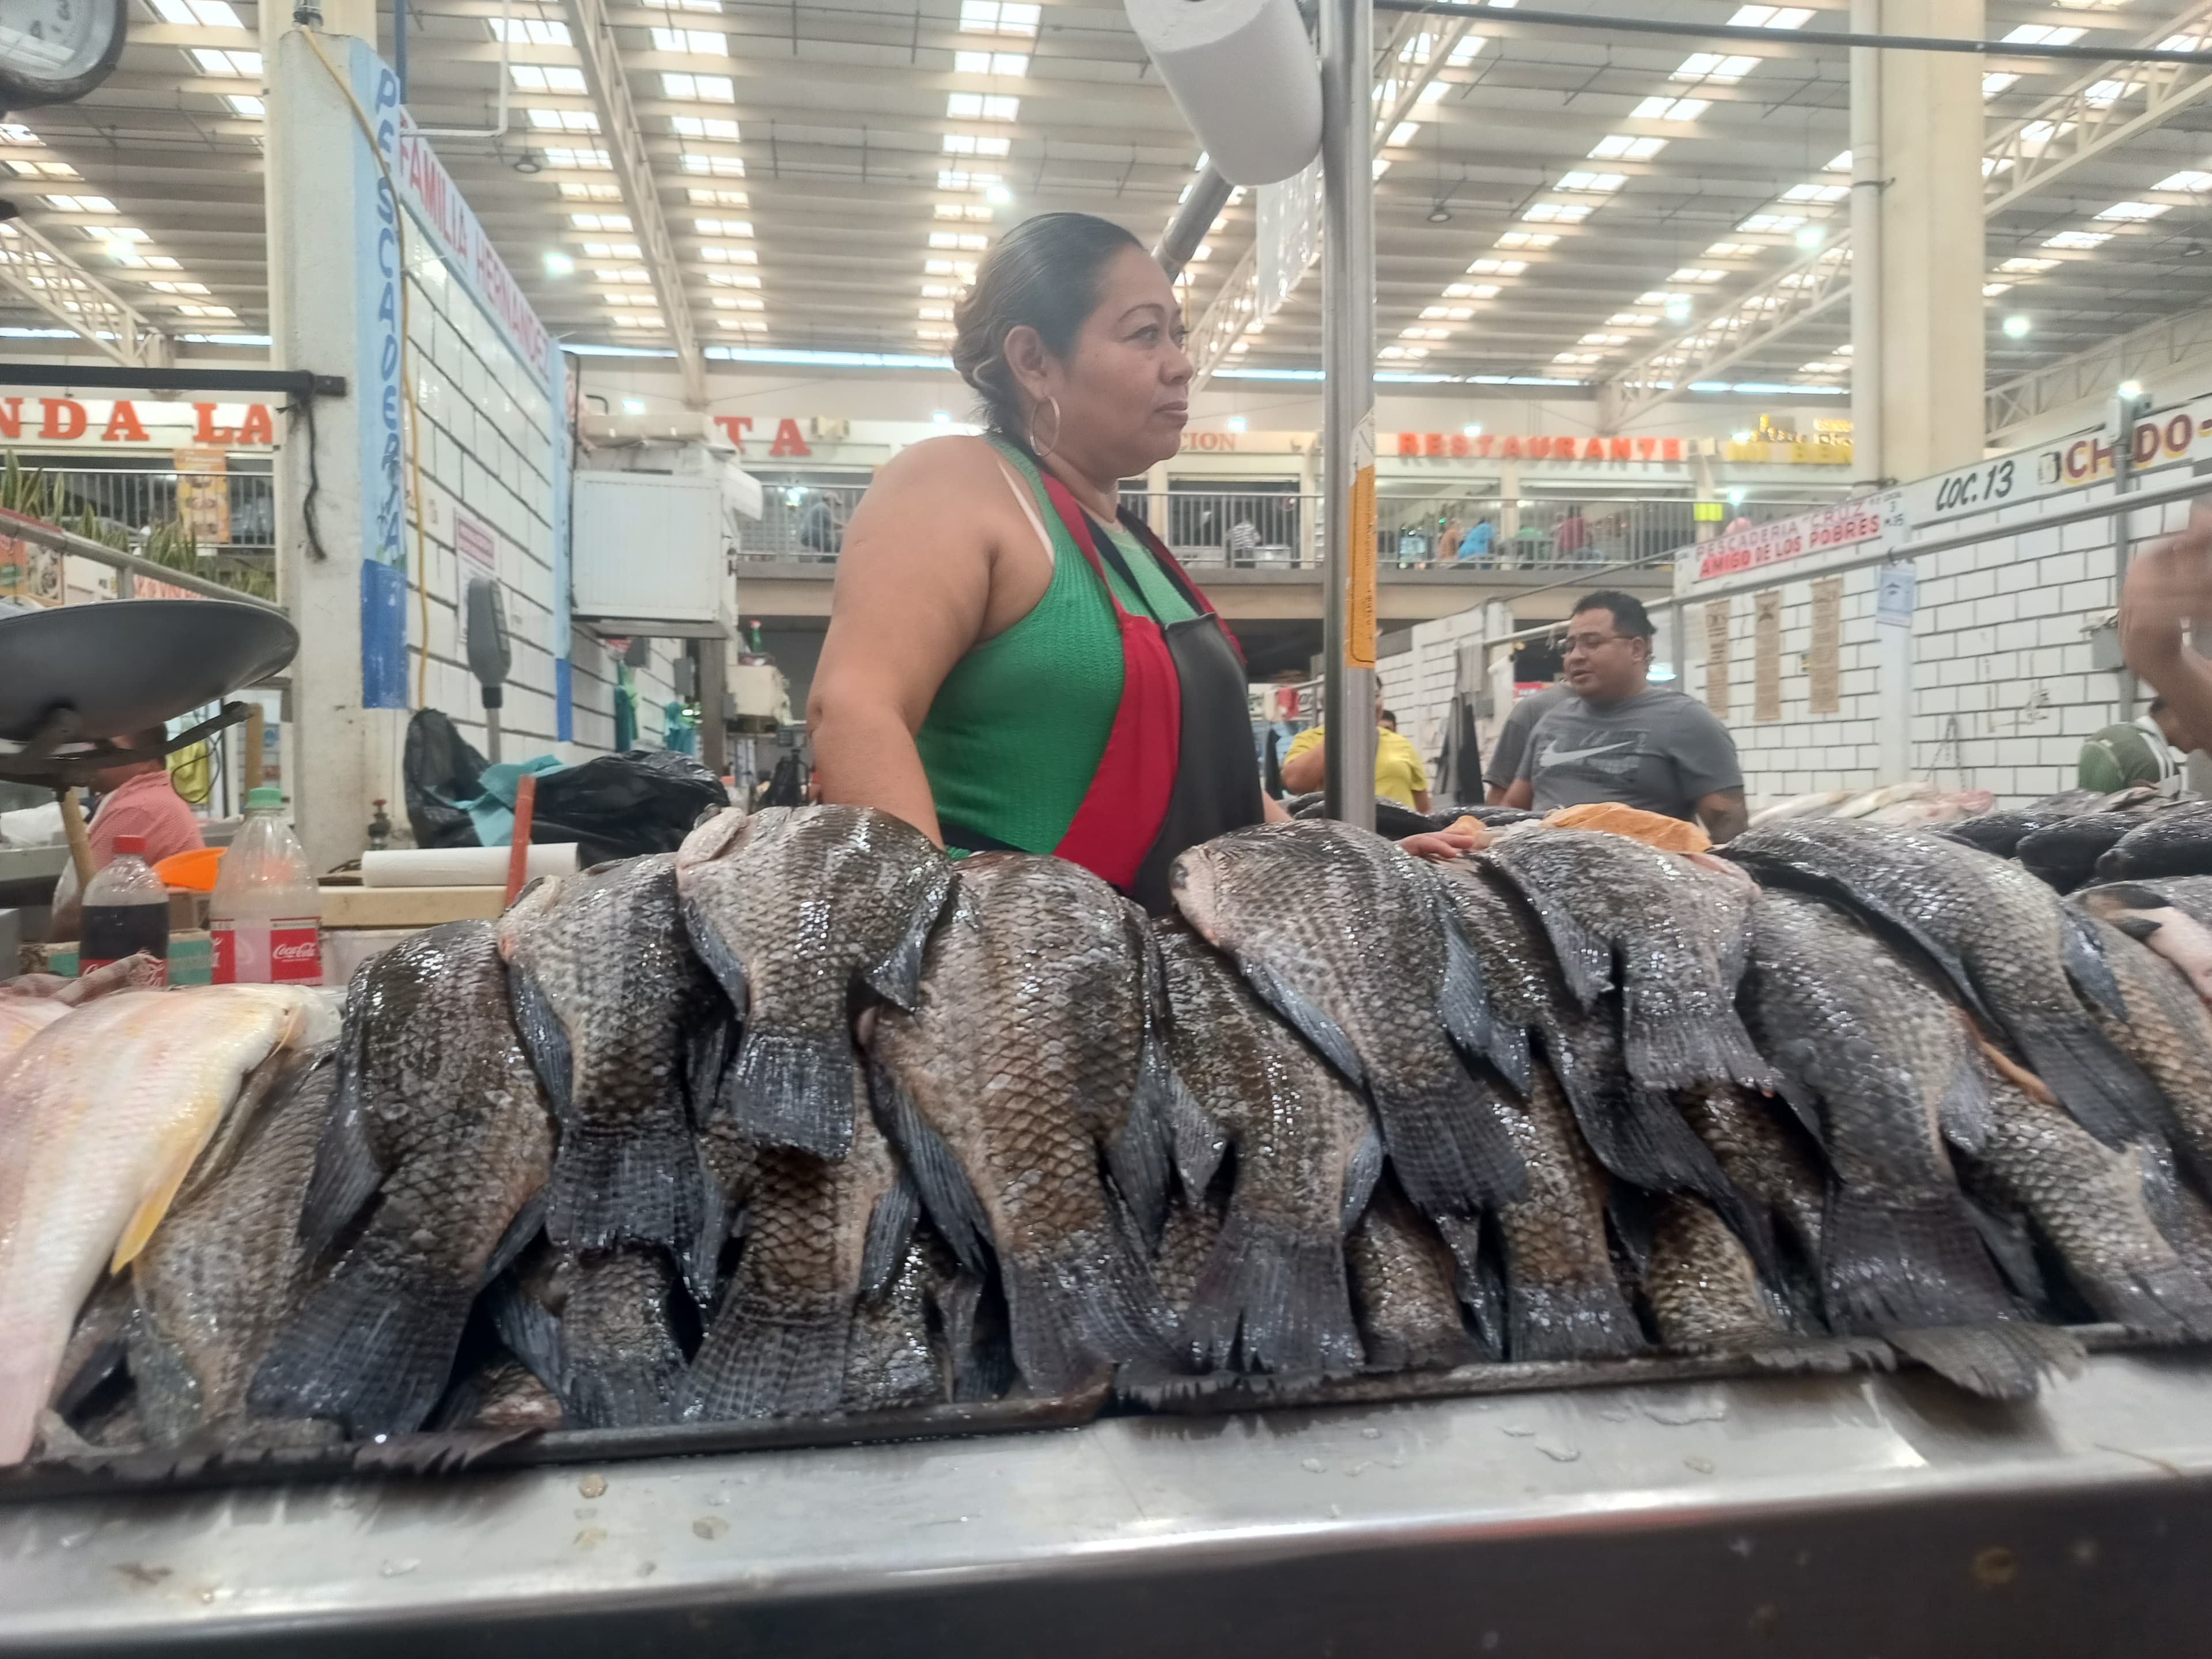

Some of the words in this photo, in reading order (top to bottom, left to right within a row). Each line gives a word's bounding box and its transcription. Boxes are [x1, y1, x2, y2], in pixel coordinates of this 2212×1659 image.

[1397, 432, 1681, 460] RESTAURANTE
[1695, 520, 1800, 562] PESCADERIA
[1700, 550, 1752, 578] AMIGO
[1755, 544, 1771, 563] DE
[1774, 535, 1802, 558] LOS
[1810, 514, 1880, 550] POBRES
